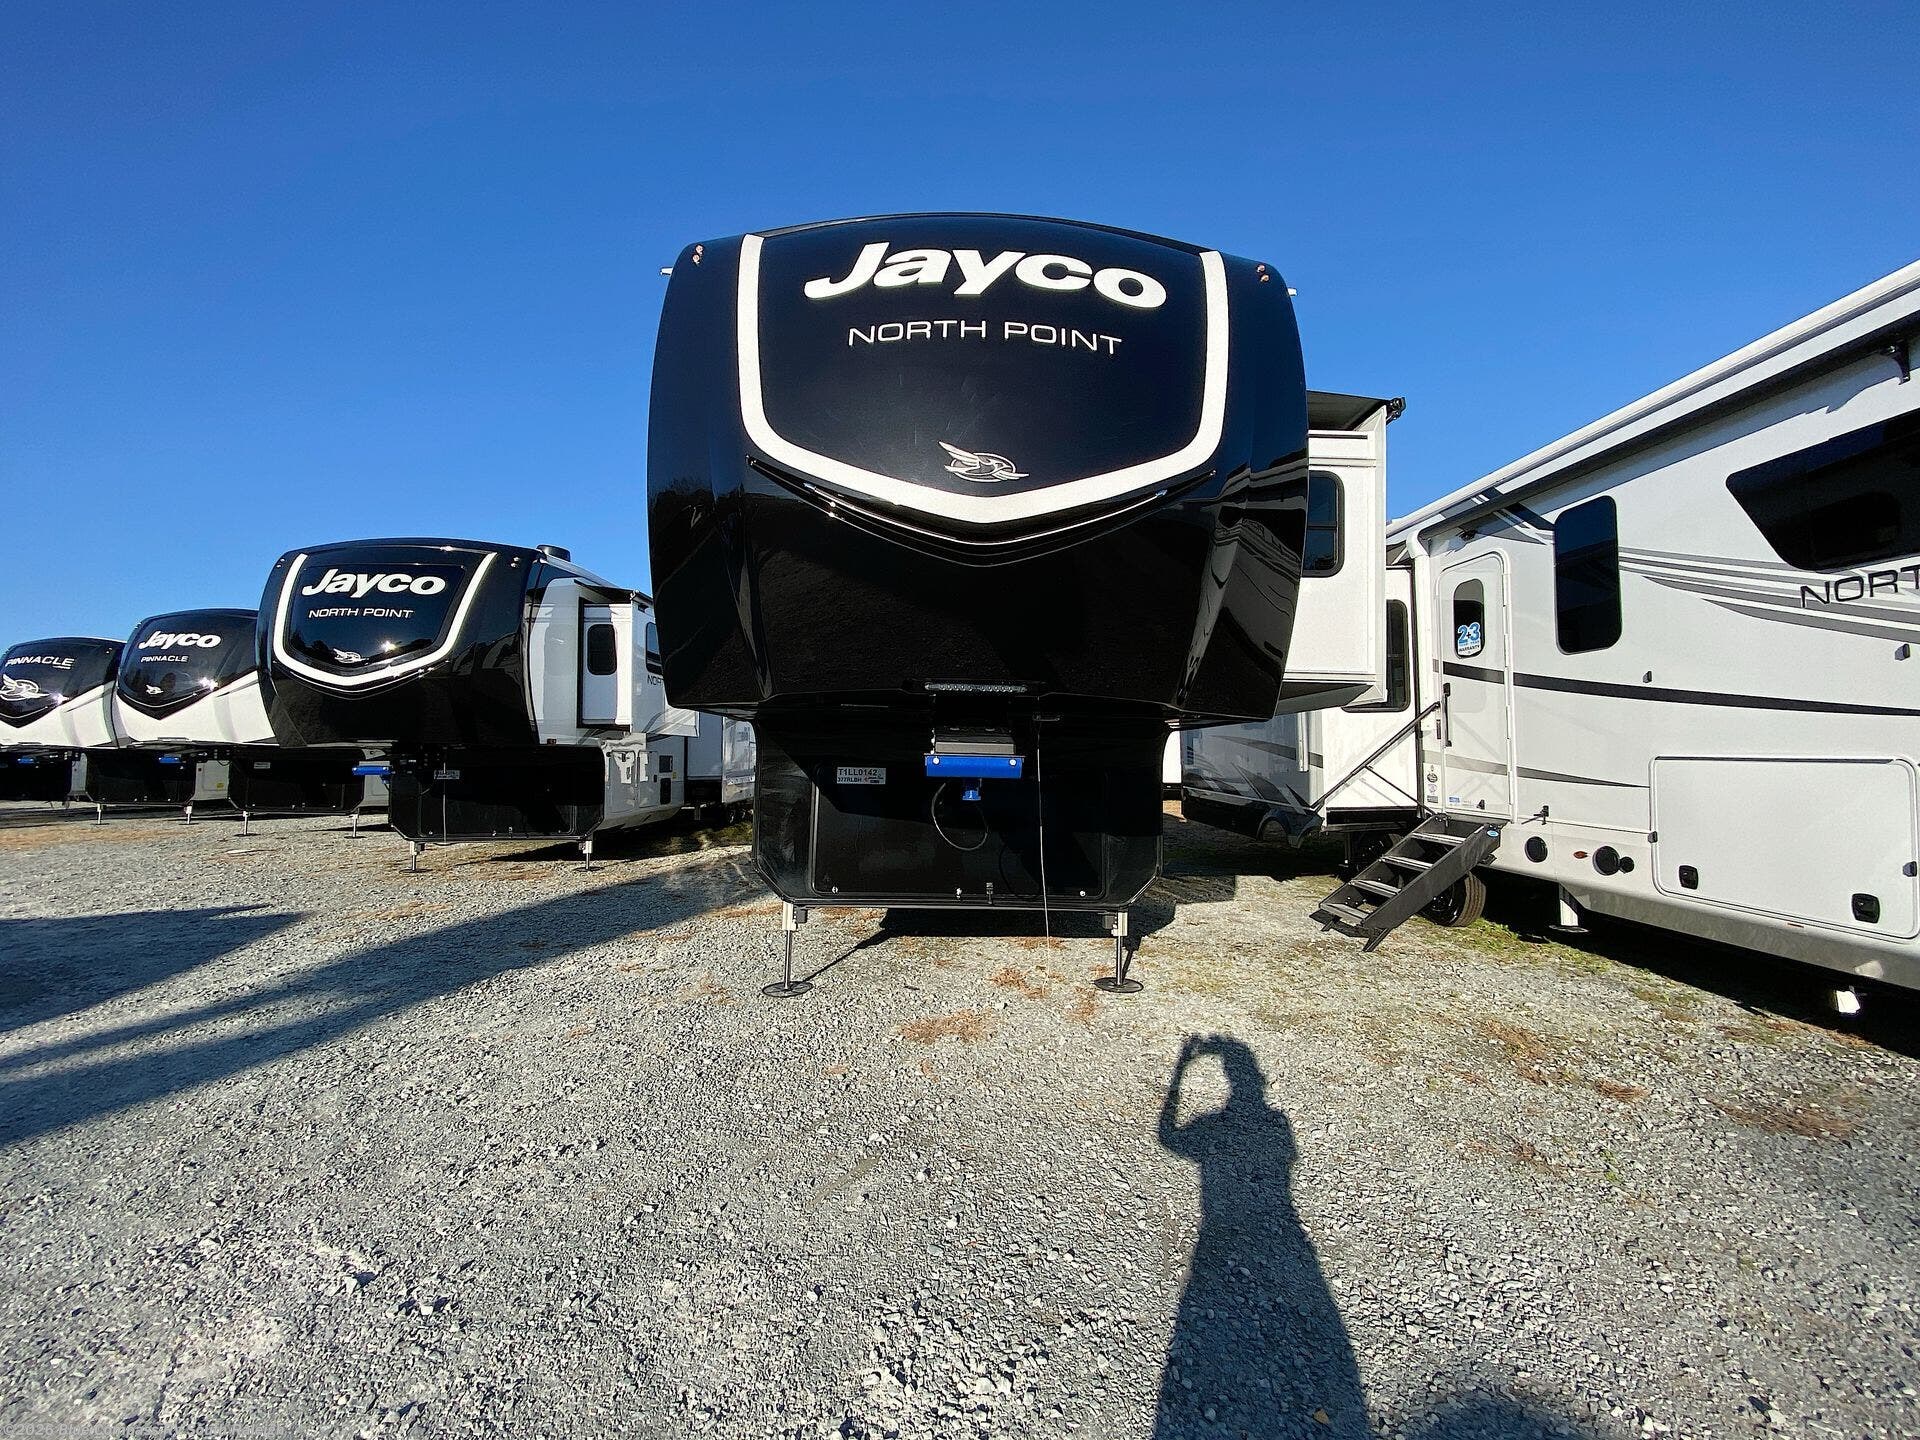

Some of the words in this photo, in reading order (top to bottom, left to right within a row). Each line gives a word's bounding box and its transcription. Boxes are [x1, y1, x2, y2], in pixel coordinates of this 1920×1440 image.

[804, 242, 1167, 308] Jayco
[848, 320, 986, 346] NORTH
[1004, 321, 1122, 355] POINT
[301, 568, 446, 598] Jayco
[308, 608, 359, 618] NORTH
[363, 608, 414, 618] POINT
[138, 631, 221, 649] Jayco
[5, 656, 75, 667] PINNACLE
